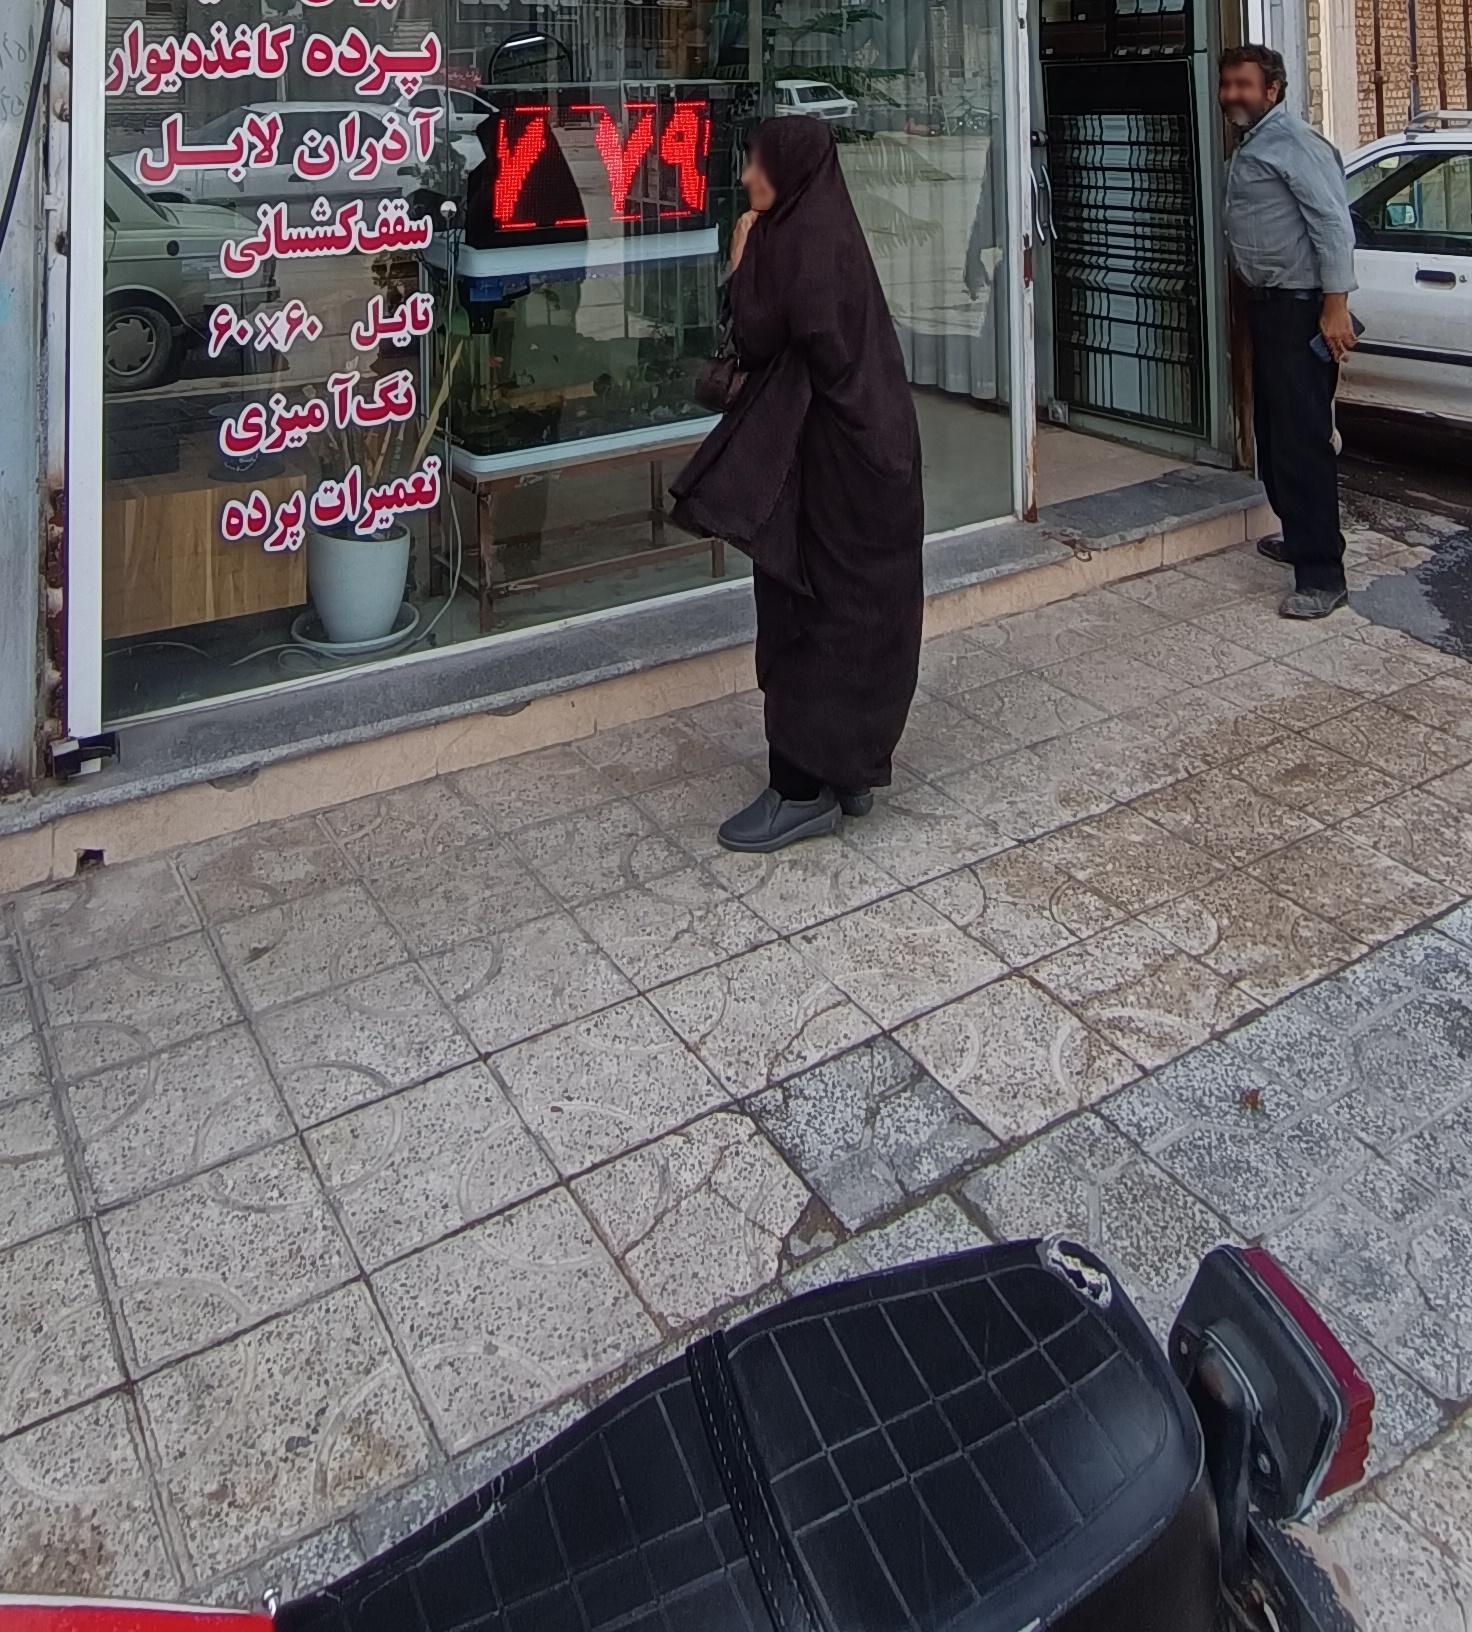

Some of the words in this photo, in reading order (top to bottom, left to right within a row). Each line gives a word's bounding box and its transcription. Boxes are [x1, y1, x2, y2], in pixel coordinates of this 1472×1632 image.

[303, 27, 441, 99] پرده
[136, 113, 282, 185] لابل
[293, 107, 443, 181] آذران
[351, 292, 434, 351] تایل
[222, 489, 305, 552] پرده
[311, 455, 441, 535] تعمیرات
